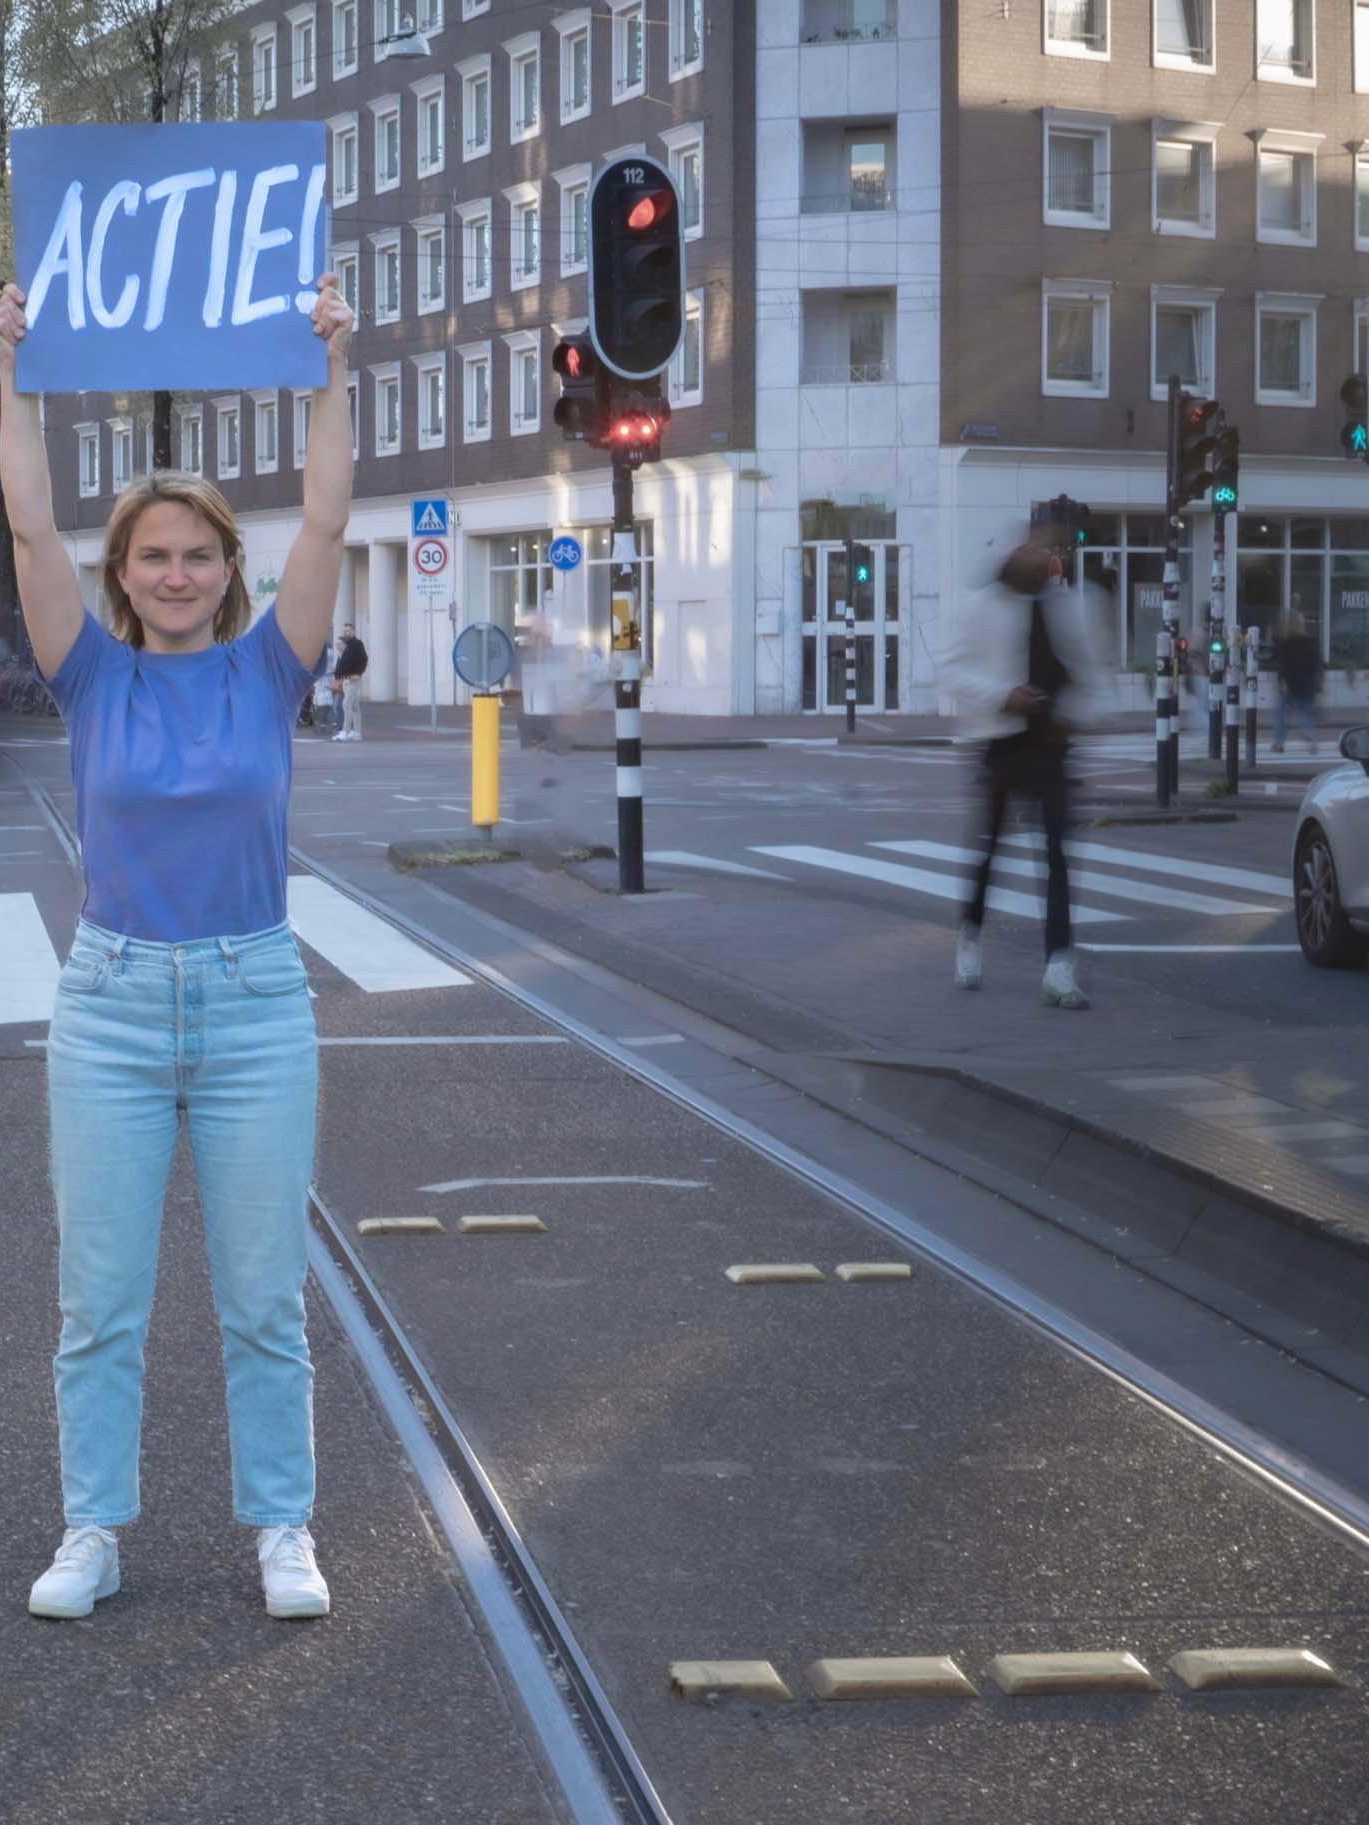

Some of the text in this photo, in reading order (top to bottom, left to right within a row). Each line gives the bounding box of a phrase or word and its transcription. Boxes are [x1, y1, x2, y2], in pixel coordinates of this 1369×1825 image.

[622, 167, 645, 185] 112
[25, 164, 326, 332] ACTIE!
[421, 550, 442, 564] 30
